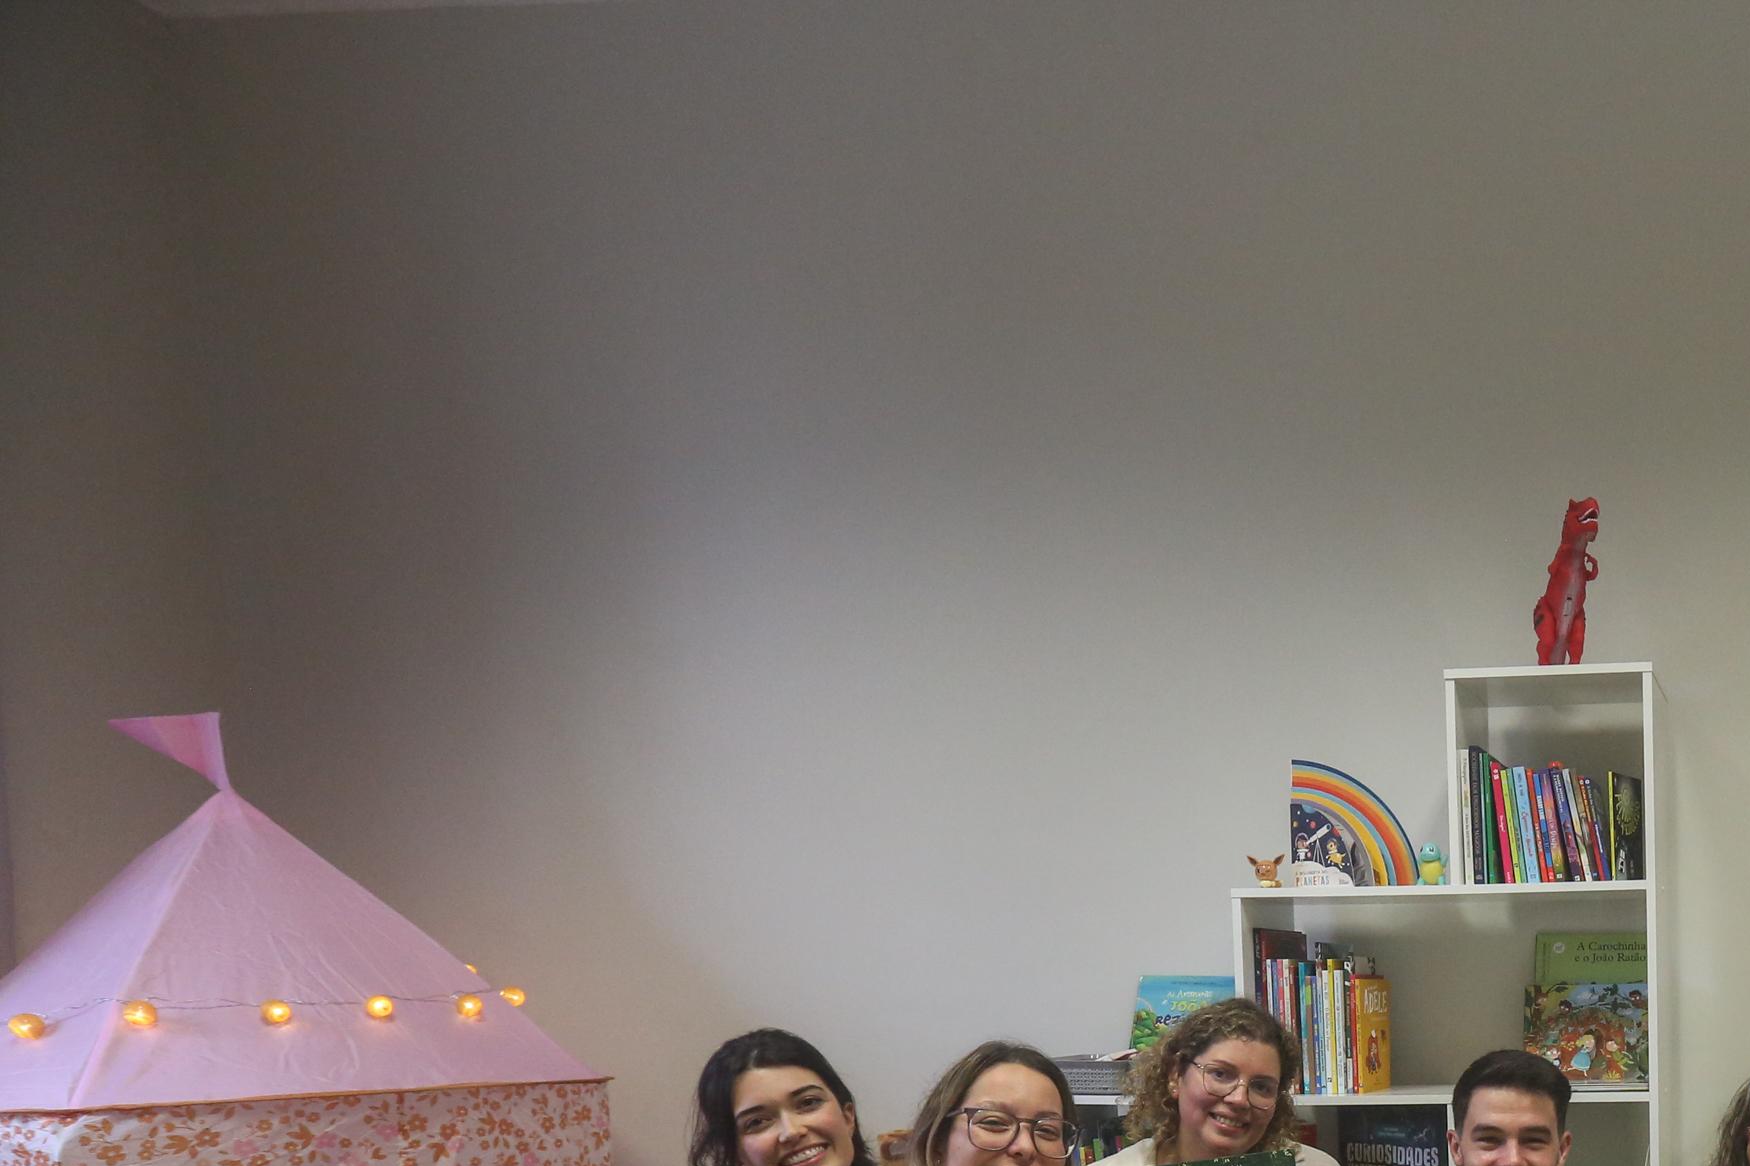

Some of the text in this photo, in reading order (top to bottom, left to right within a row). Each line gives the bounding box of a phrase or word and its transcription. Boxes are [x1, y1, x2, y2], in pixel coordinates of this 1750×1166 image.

[1577, 941, 1646, 951] A Carochinha
[1592, 953, 1614, 963] João
[1617, 953, 1646, 962] Ratão
[1346, 1142, 1439, 1166] CURIOSIDADES
